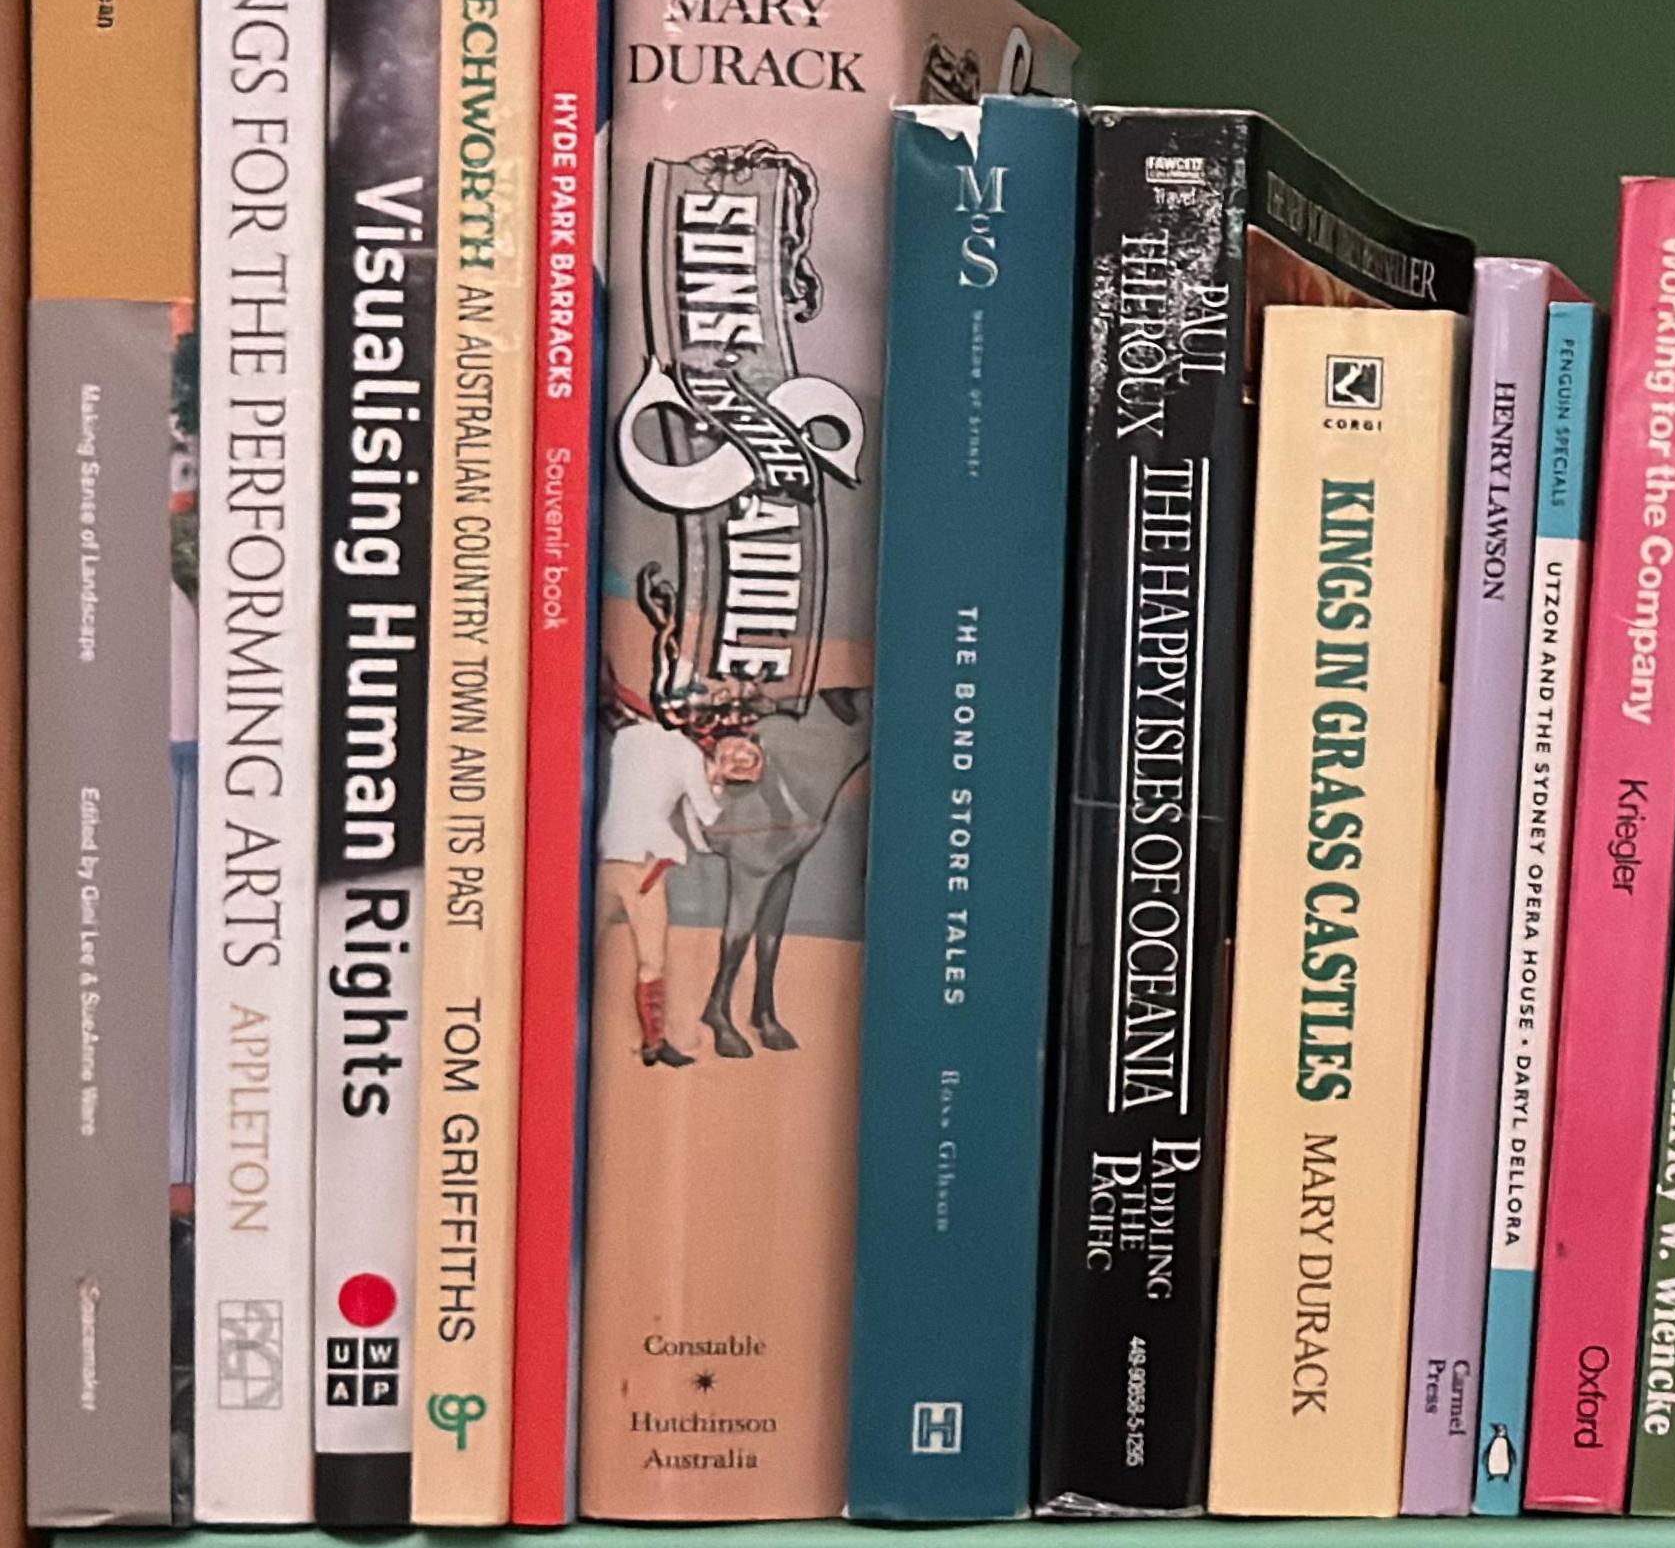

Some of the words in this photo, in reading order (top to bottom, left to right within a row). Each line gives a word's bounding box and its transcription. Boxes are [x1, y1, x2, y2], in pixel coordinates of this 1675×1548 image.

[629, 42, 866, 94] DURACK
[552, 92, 578, 165] HYDE
[228, 120, 290, 239] FOR
[551, 173, 577, 246] PARK
[227, 253, 288, 376] THE
[458, 285, 494, 322] AN
[546, 255, 575, 400] BARRACKS
[679, 190, 766, 347] SONS
[728, 420, 811, 488] THE
[1116, 228, 1169, 440] THEROUX
[1177, 284, 1229, 386] PAUL
[76, 383, 101, 456] Making
[335, 176, 424, 578] Visualising
[454, 334, 494, 503] AUSTRALIAN
[1556, 338, 1576, 422] PENGUIN
[1323, 418, 1383, 432] CORGI
[1488, 381, 1517, 476] HENRY
[1551, 427, 1570, 508] SPECIALS
[79, 529, 101, 550] of
[80, 461, 101, 524] Sense
[544, 448, 571, 558] Souvenir
[1141, 459, 1193, 552] THE
[452, 516, 491, 645] COUNTRY
[1315, 478, 1375, 631] KINGS
[1482, 483, 1512, 601] LAWSON
[78, 556, 101, 662] Landscape
[223, 397, 287, 799] PERFORMING
[542, 563, 568, 630] book
[956, 606, 979, 665] THE
[1137, 564, 1190, 709] HAPPY
[1543, 561, 1563, 644] UTZON
[1621, 536, 1674, 726] Company
[451, 655, 488, 734] TOWN
[1315, 639, 1369, 693] IN
[1539, 653, 1556, 701] AND
[344, 603, 417, 861] Human
[450, 745, 486, 802] AND
[952, 683, 976, 771] BOND
[1131, 717, 1186, 825] ISLES
[1535, 709, 1554, 754] THE
[80, 787, 100, 851] Edited
[1307, 701, 1368, 872] GRASS
[1530, 762, 1550, 854] SYDNEY
[76, 856, 100, 879] by
[449, 814, 485, 854] ITS
[947, 789, 973, 892] STORE
[1130, 833, 1183, 895] OF
[1606, 778, 1649, 896] Kriegler
[223, 819, 281, 970] ARTS
[446, 865, 484, 930] PAST
[1524, 864, 1544, 940] OPERA
[329, 889, 411, 1118] Rights
[944, 909, 969, 1005] TALES
[1296, 881, 1360, 1103] CASTLES
[1518, 951, 1538, 1029] HOUSE
[443, 997, 481, 1092] TOM
[1122, 901, 1181, 1112] OCEANIA
[227, 1003, 270, 1233] APPLETON
[940, 1069, 960, 1129] Ross
[1511, 1055, 1531, 1129] DARYL
[438, 1114, 479, 1343] GRIFFITHS
[1087, 1152, 1142, 1272] PACIFIC
[1120, 1183, 1146, 1251] THE
[1147, 1137, 1201, 1300] PADDLING
[1299, 1131, 1338, 1245] MARY
[1504, 1138, 1526, 1247] DELLORA
[643, 1333, 766, 1357] Constable
[1291, 1253, 1334, 1418] DURACK
[629, 1411, 777, 1435] Hutchinson
[1425, 1358, 1446, 1415] Press
[1449, 1358, 1471, 1437] Carmel
[1574, 1345, 1610, 1450] Oxford
[643, 1447, 759, 1470] Australia
